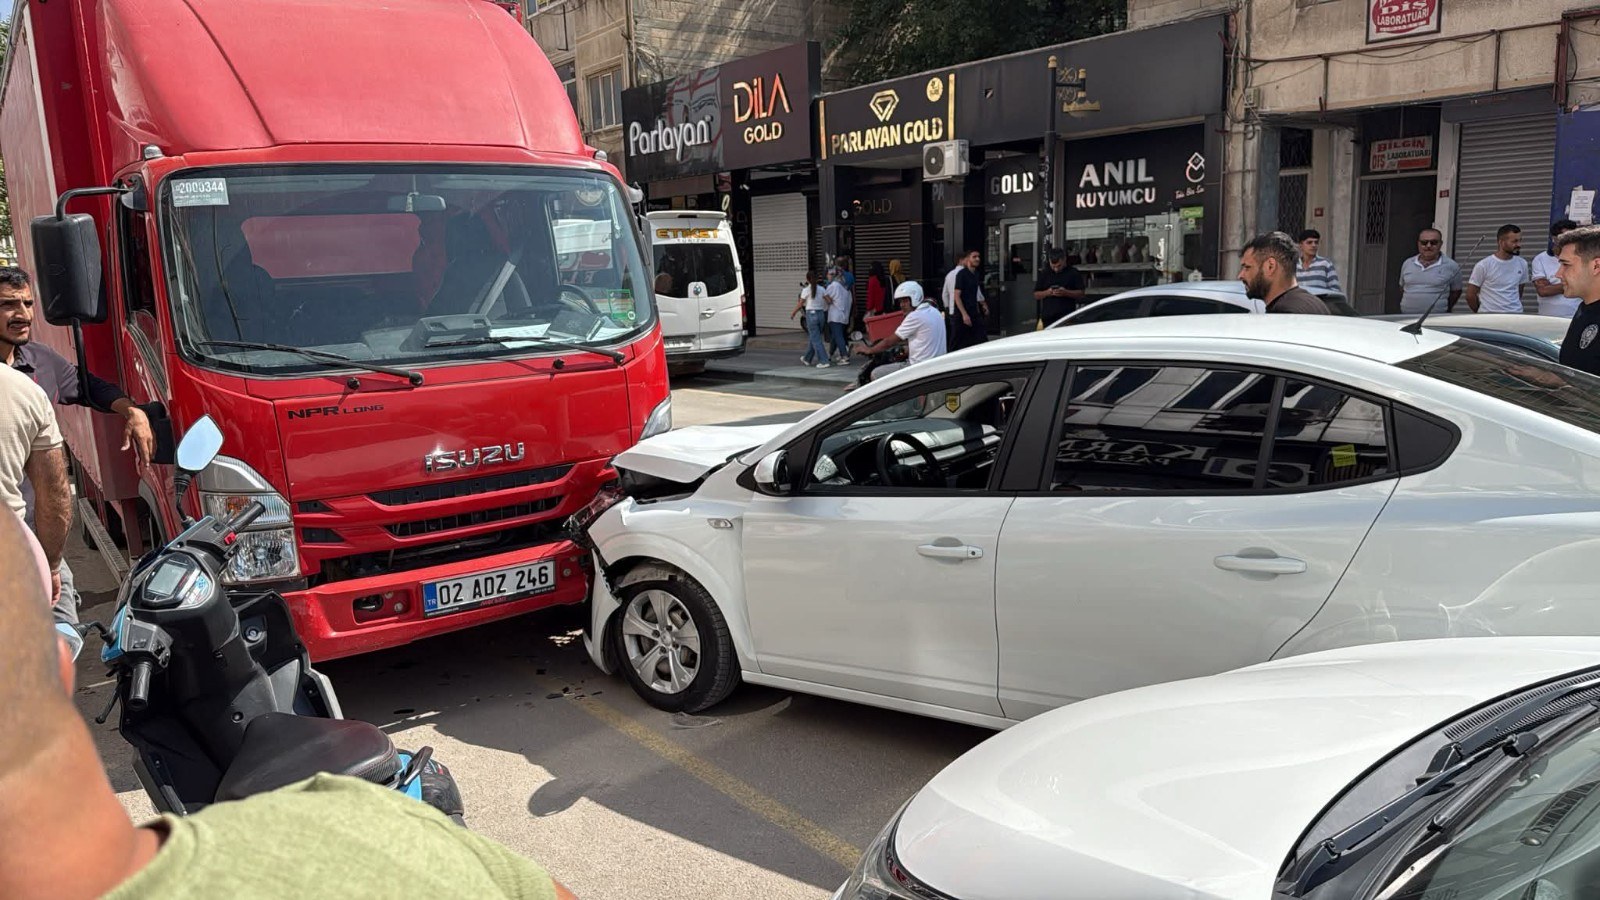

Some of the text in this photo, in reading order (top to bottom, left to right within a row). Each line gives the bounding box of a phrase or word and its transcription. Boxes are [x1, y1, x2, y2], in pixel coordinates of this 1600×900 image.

[1377, 7, 1430, 26] LABORATUARI
[629, 116, 712, 160] Parlayan
[743, 121, 783, 144] GOLD
[831, 117, 944, 153] PARLAYAN GOLD
[991, 172, 1034, 195] GOLD
[1078, 158, 1154, 188] ANIL
[853, 199, 892, 216] GOLD
[1076, 187, 1156, 209] KUYUMCU
[288, 404, 385, 420] NPR LONG
[425, 442, 525, 473] ISUZU
[439, 565, 549, 605] 02 ADZ 246
[427, 598, 436, 606] TR
